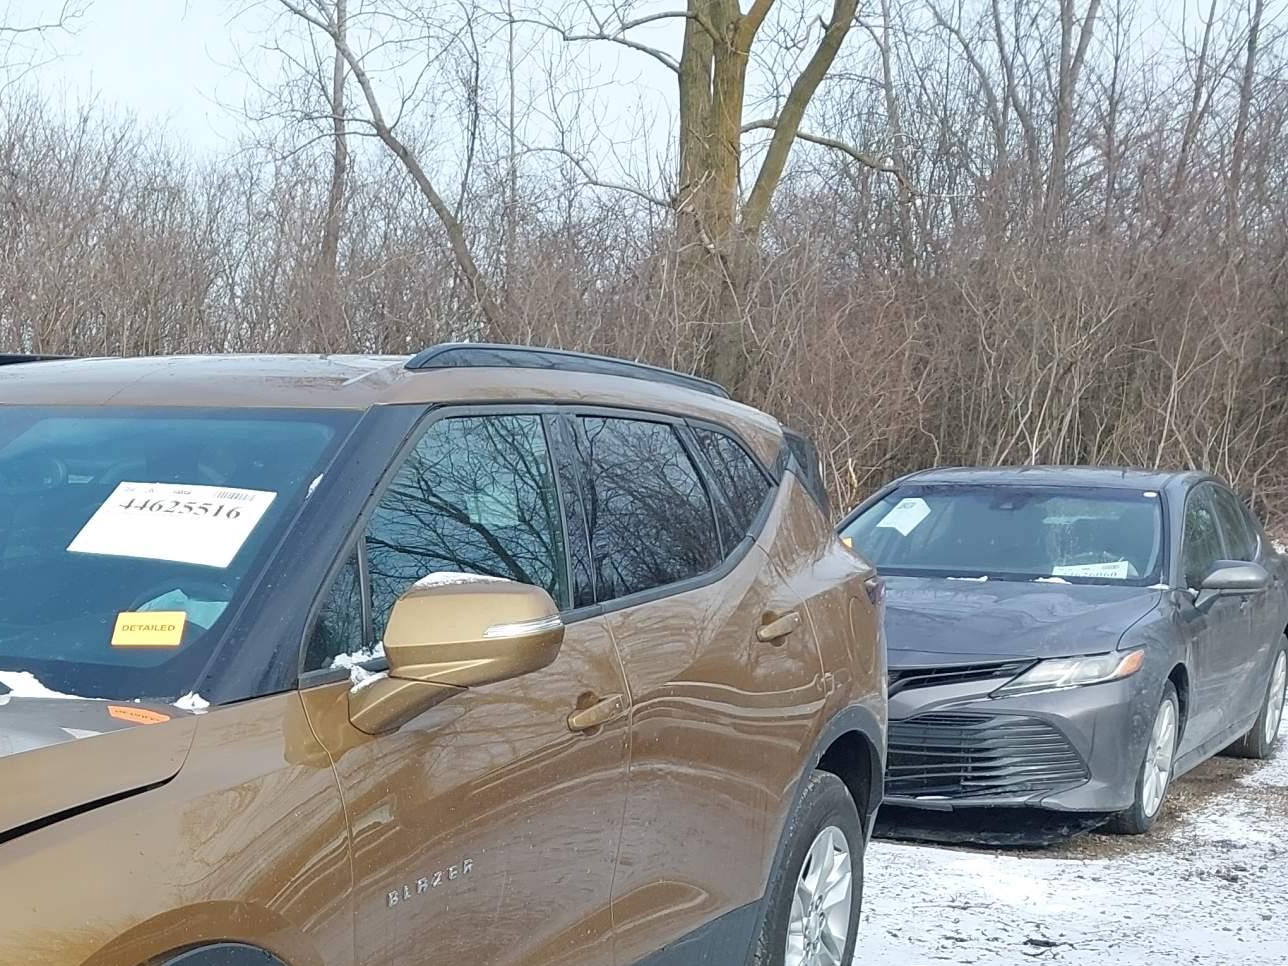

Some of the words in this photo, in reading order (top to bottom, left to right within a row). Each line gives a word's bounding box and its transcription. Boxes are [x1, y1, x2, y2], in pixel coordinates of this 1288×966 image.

[120, 498, 241, 519] 44625516
[121, 624, 176, 632] DETAILED
[387, 858, 473, 907] BLAZER
